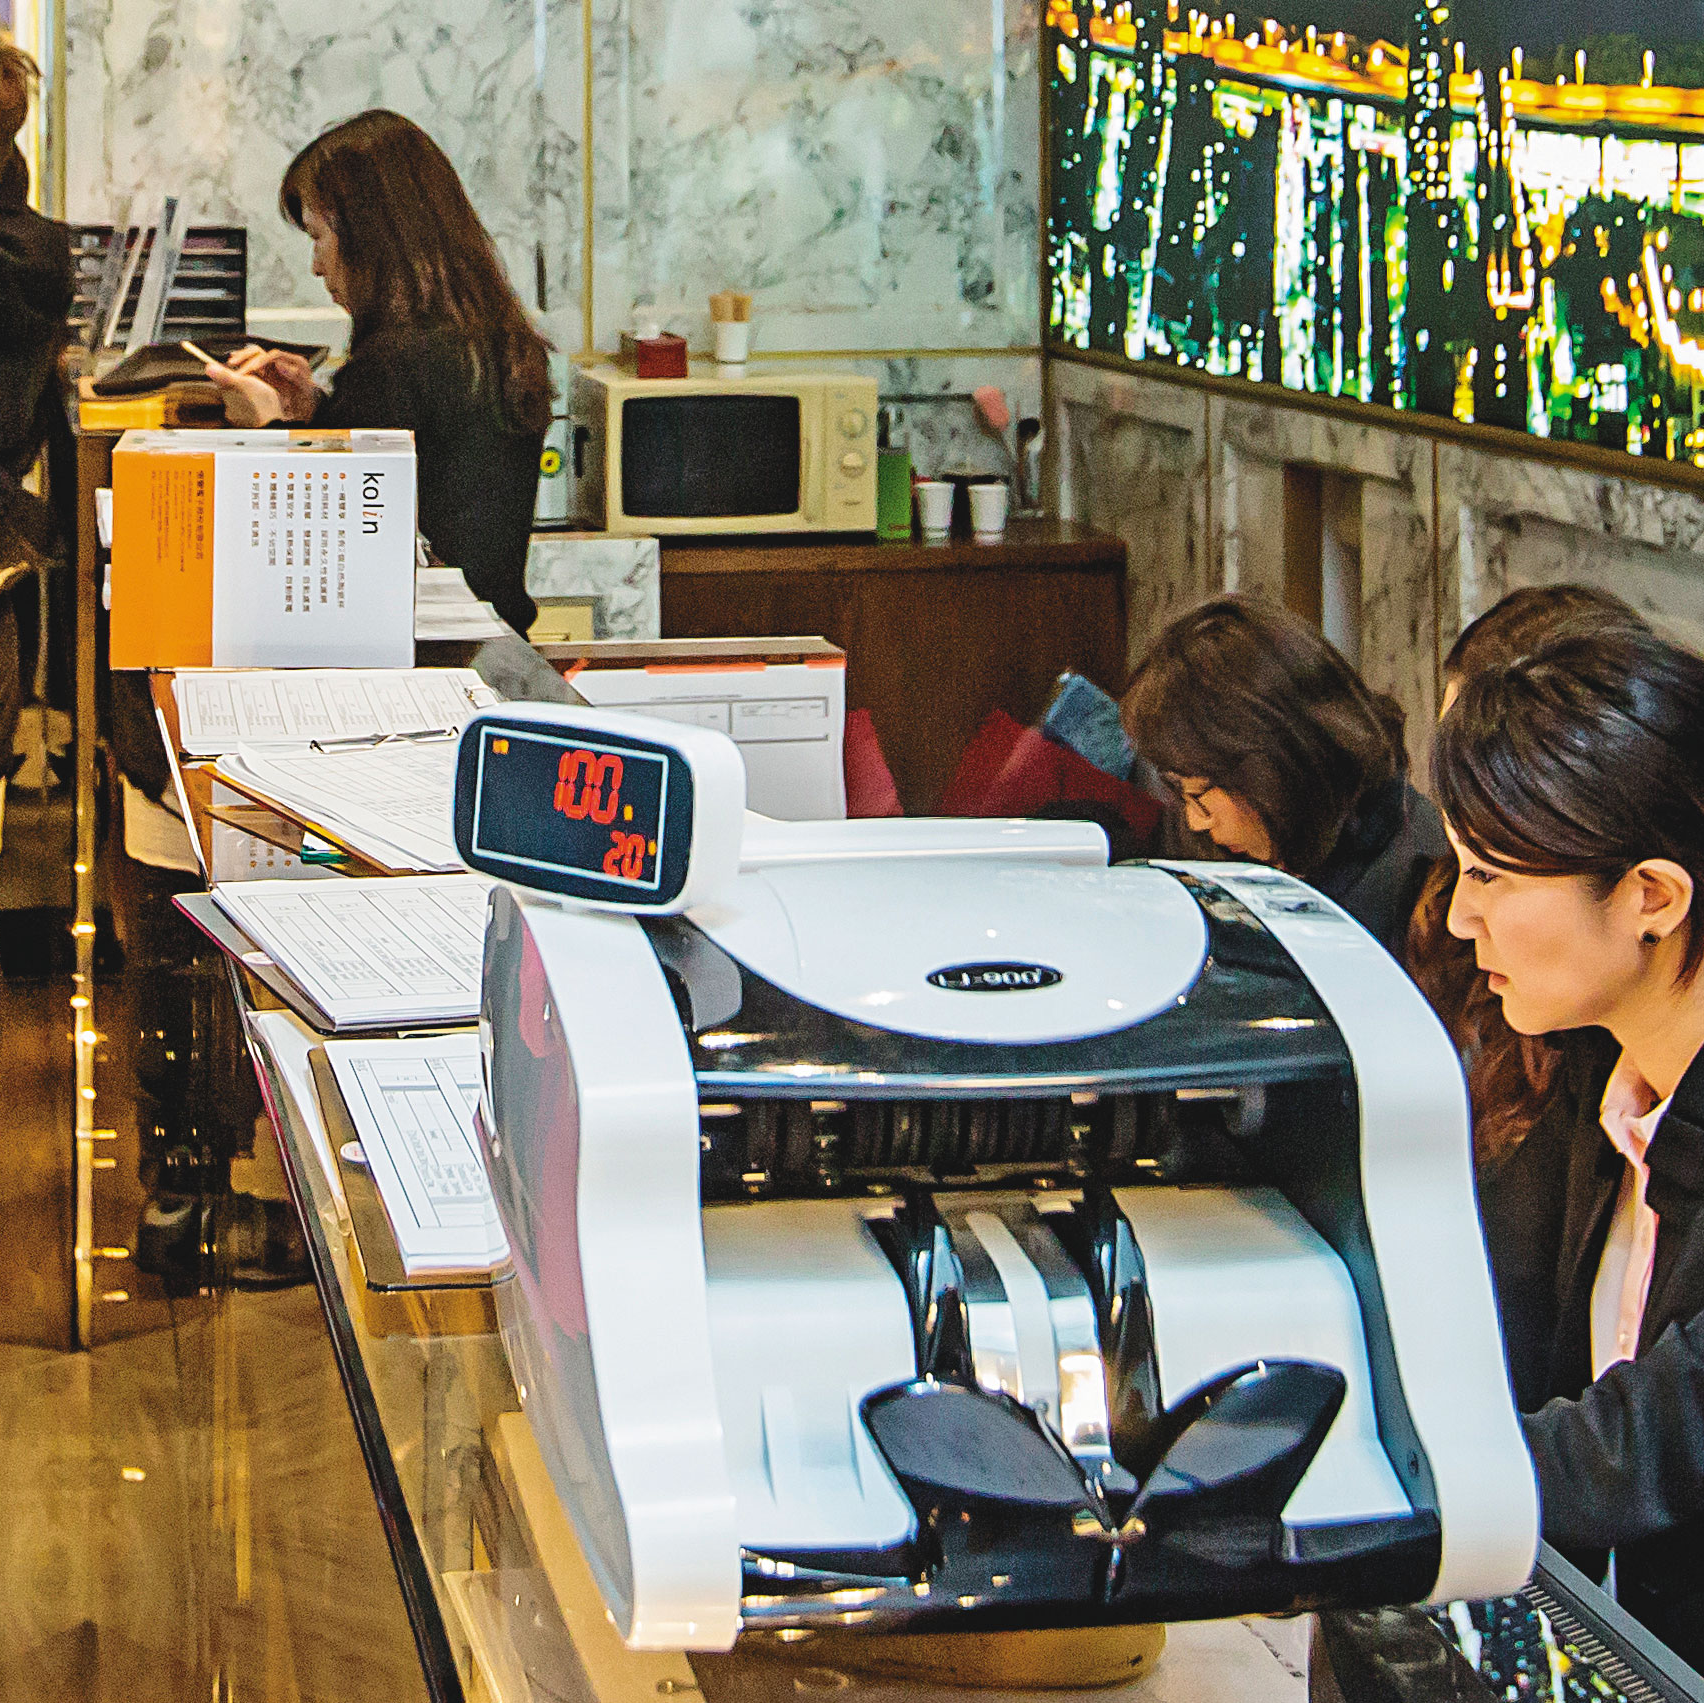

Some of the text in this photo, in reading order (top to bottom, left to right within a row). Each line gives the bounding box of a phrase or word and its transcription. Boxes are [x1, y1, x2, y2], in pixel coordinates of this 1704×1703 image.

[362, 472, 385, 535] kolin
[553, 749, 624, 825] 100
[603, 830, 646, 880] 20
